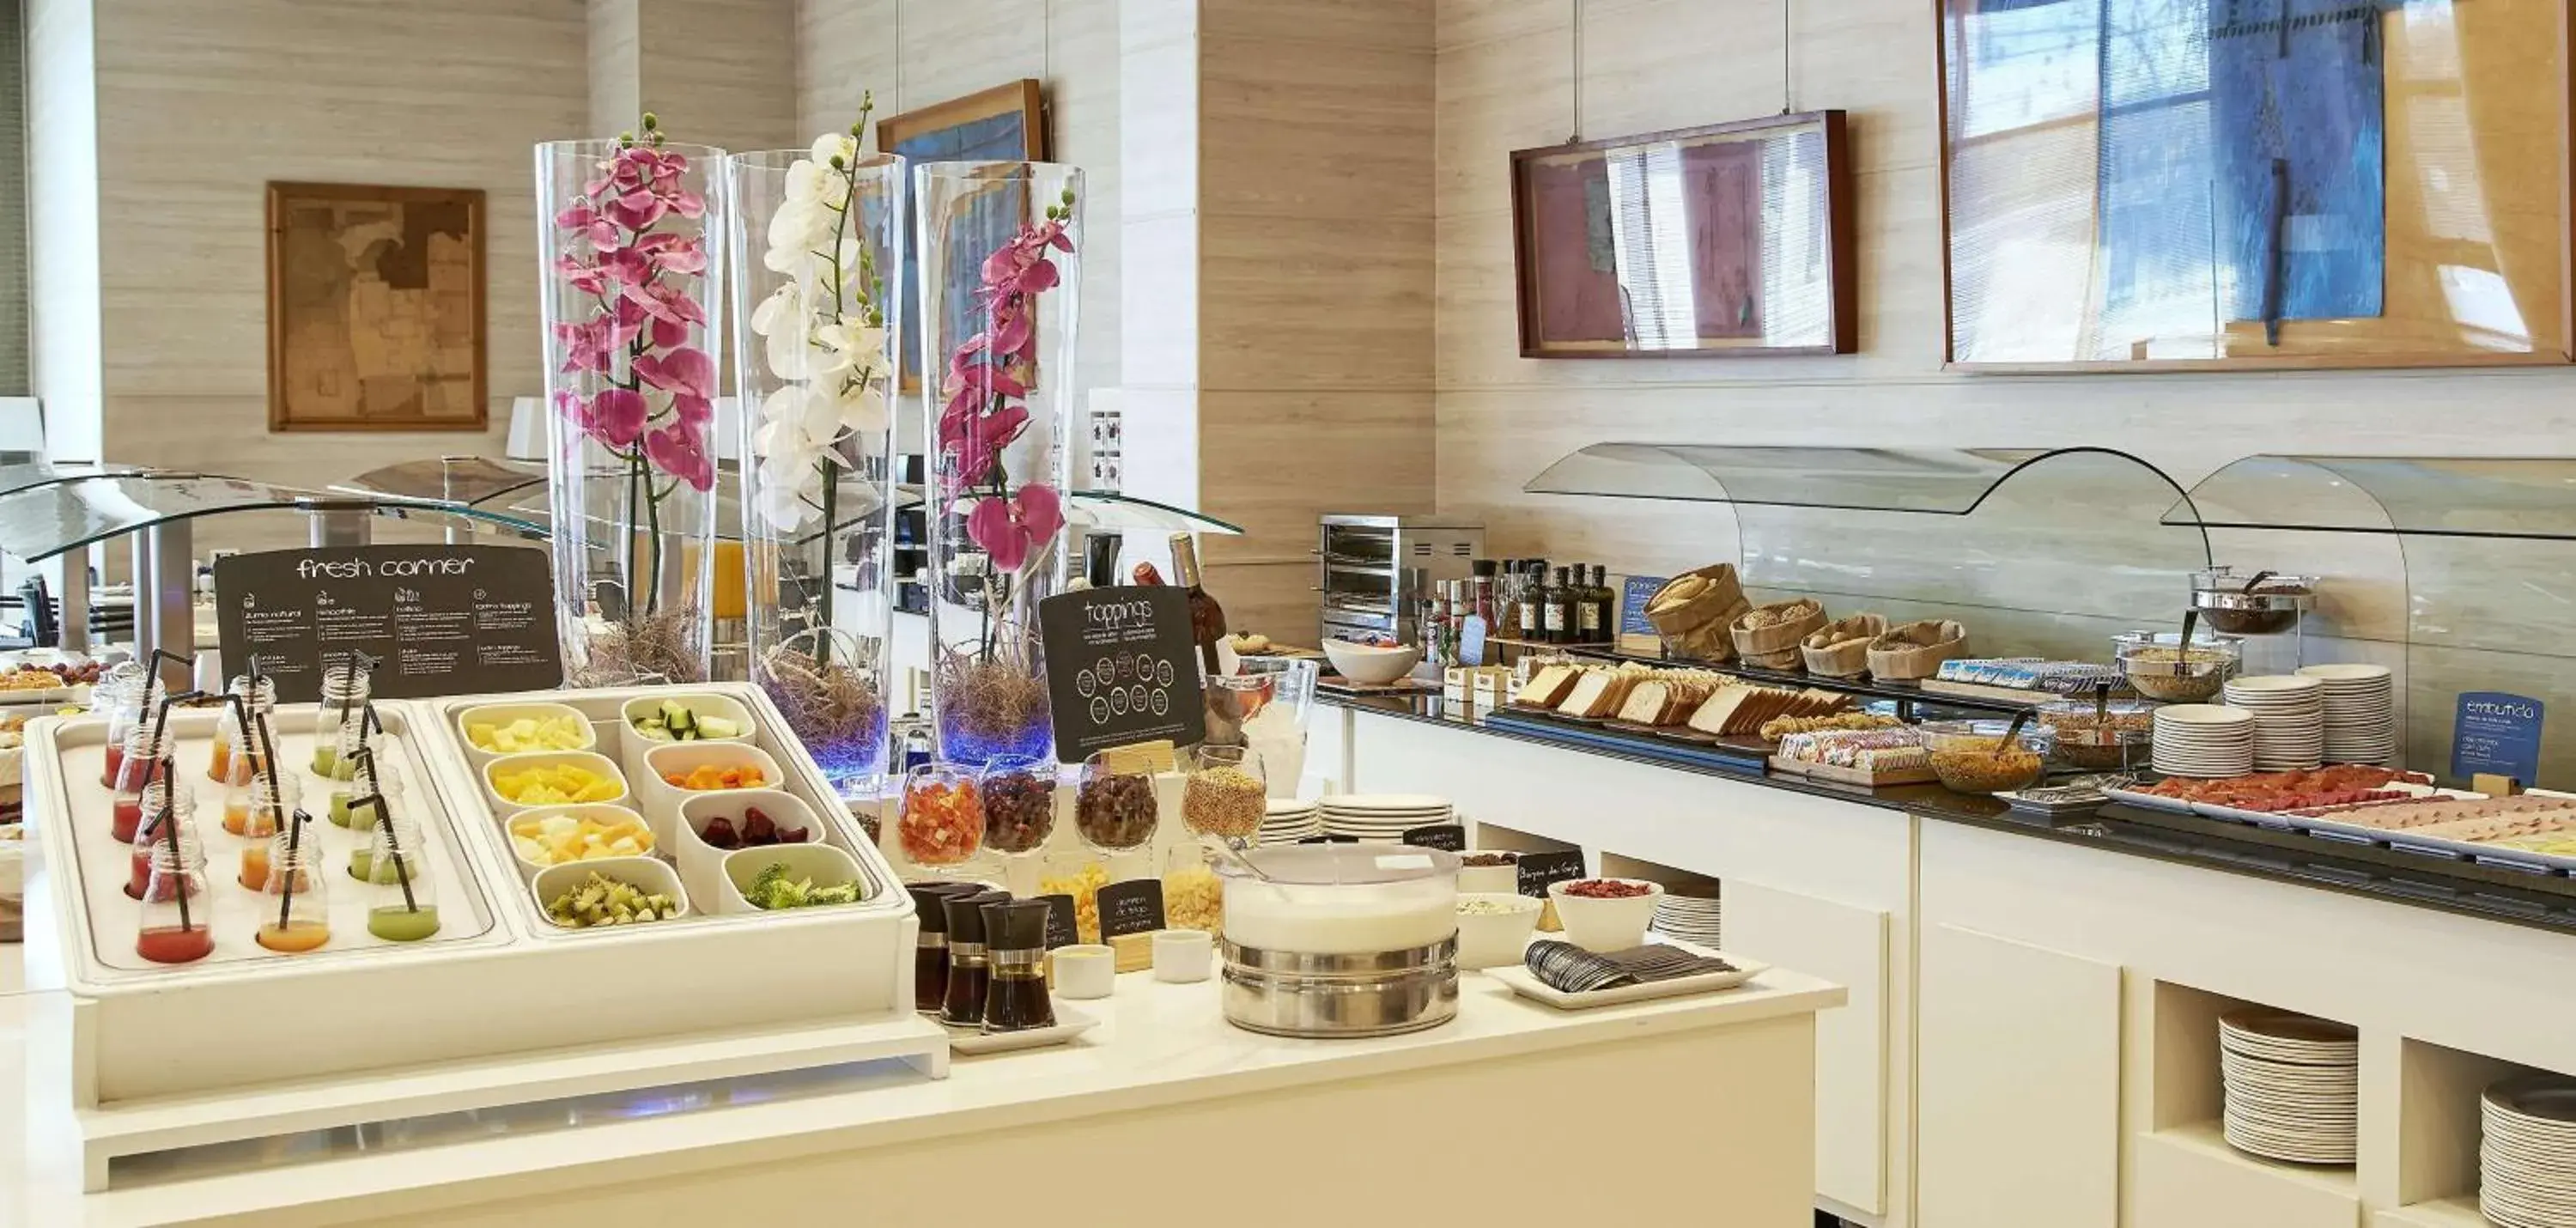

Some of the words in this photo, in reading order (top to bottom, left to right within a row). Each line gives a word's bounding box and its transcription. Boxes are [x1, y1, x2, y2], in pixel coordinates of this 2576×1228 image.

[296, 557, 372, 580] fresh
[380, 557, 475, 577] corner
[1084, 596, 1153, 630] toppings
[2467, 700, 2535, 719] embutido
